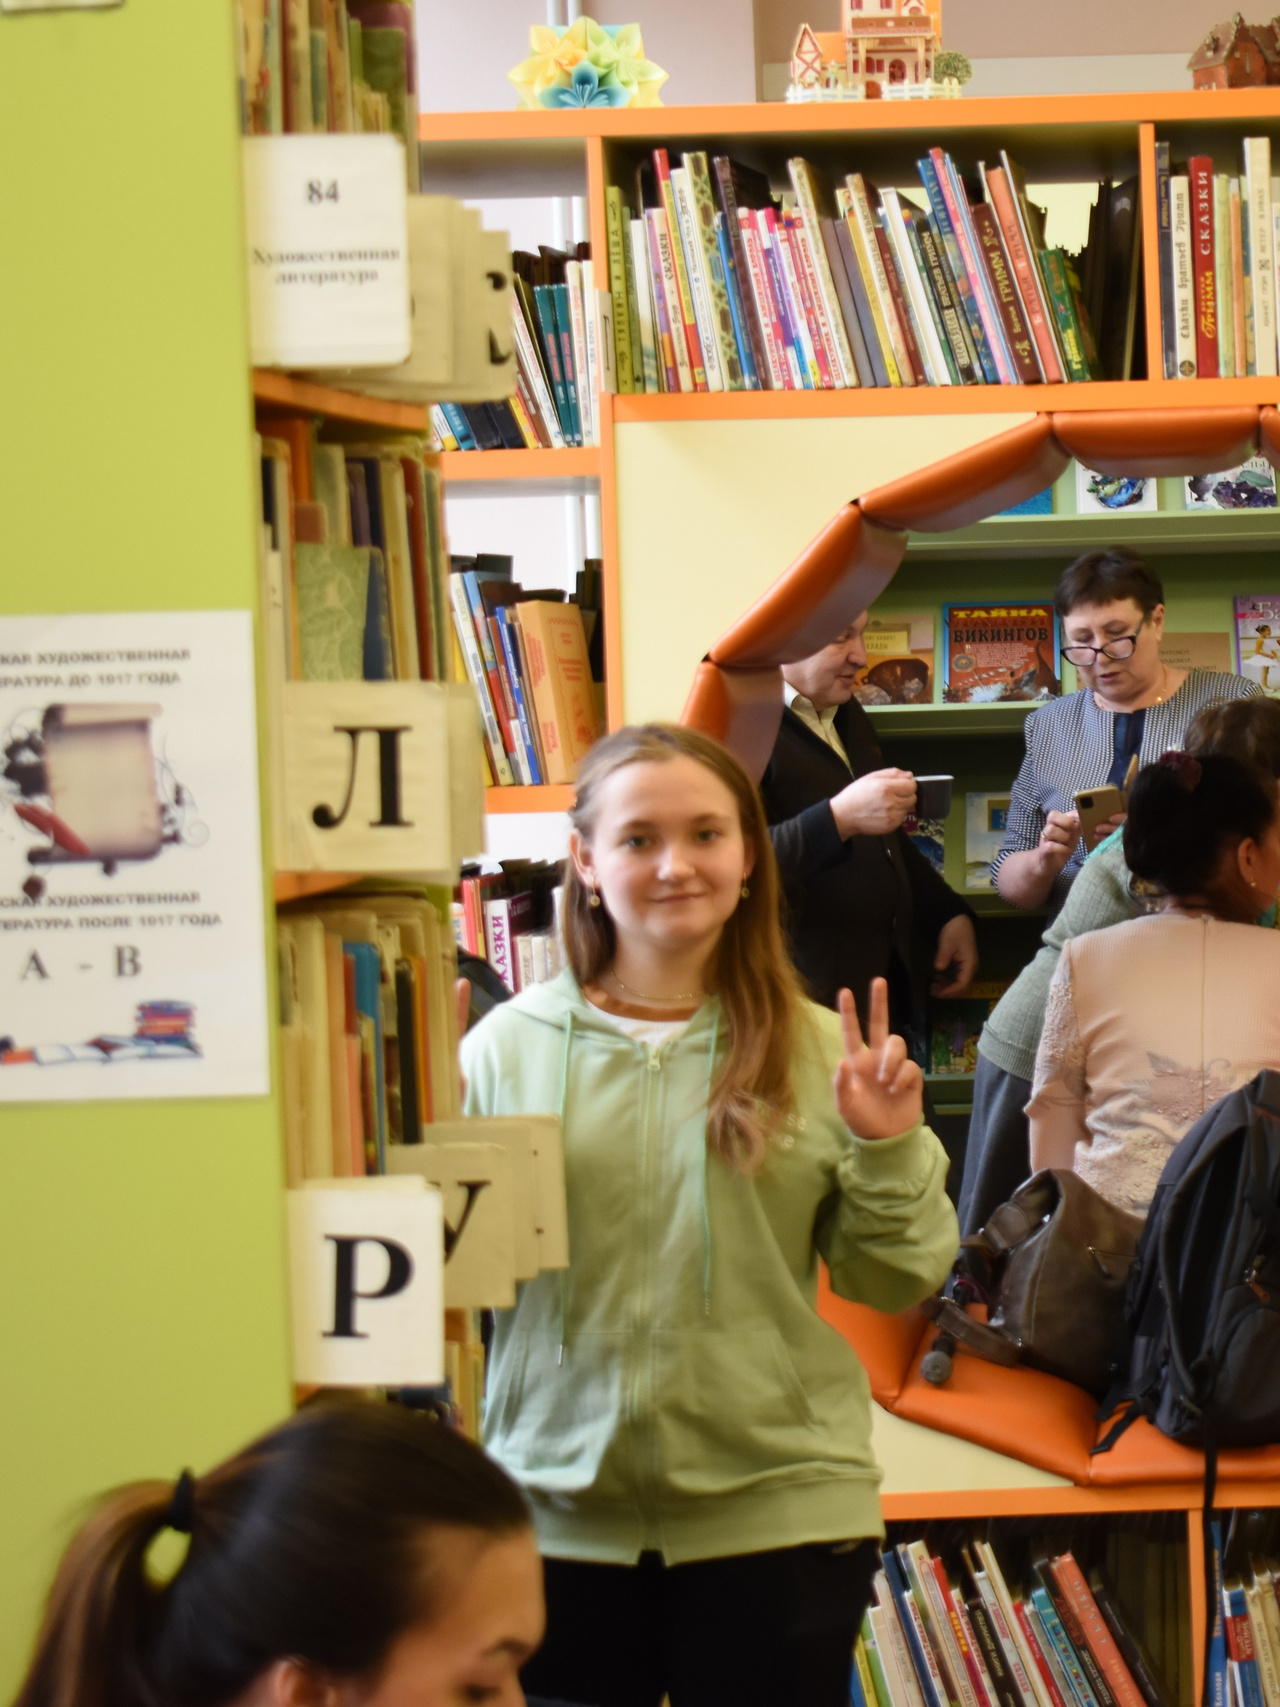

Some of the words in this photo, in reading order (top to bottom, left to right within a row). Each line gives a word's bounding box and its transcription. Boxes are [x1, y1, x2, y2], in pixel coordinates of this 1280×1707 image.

[307, 180, 340, 204] 84
[1197, 171, 1211, 256] СКАЗКИ
[657, 231, 675, 281] СКАЗКИ
[799, 236, 813, 269] КОРОЛЬ
[921, 230, 939, 267] ГРИММ
[1258, 226, 1267, 253] ВЕТЕР
[253, 248, 401, 268] Художественная
[275, 268, 379, 286] литература
[932, 267, 951, 307] БРАТЬЕВ
[988, 250, 1014, 302] ГРИММ
[1007, 305, 1022, 334] Братья
[953, 608, 1048, 619] ТАЙНА
[953, 627, 1049, 643] ВИКИНГОВ
[37, 649, 192, 665] ХУДОЖЕСТВЕННАЯ
[69, 674, 92, 688] ДО
[99, 673, 132, 687] 1917
[138, 672, 181, 686] ГОДА
[312, 725, 415, 829] Л
[47, 892, 201, 907] ХУДОЖЕСТВЕННАЯ
[79, 916, 133, 929] ПОСЛЕ
[139, 914, 174, 927] 1917
[179, 913, 222, 926] ГОДА
[20, 948, 52, 980] А
[113, 944, 142, 977] В
[491, 915, 507, 981] КАЗКИ
[322, 1233, 415, 1339] Р
[1069, 1577, 1111, 1645] СКАЗКИ
[947, 1610, 971, 1653] СКАЗКИ
[974, 1607, 997, 1650] ДЖУНГЛЕЙ
[989, 1649, 1006, 1677] КНИГИ
